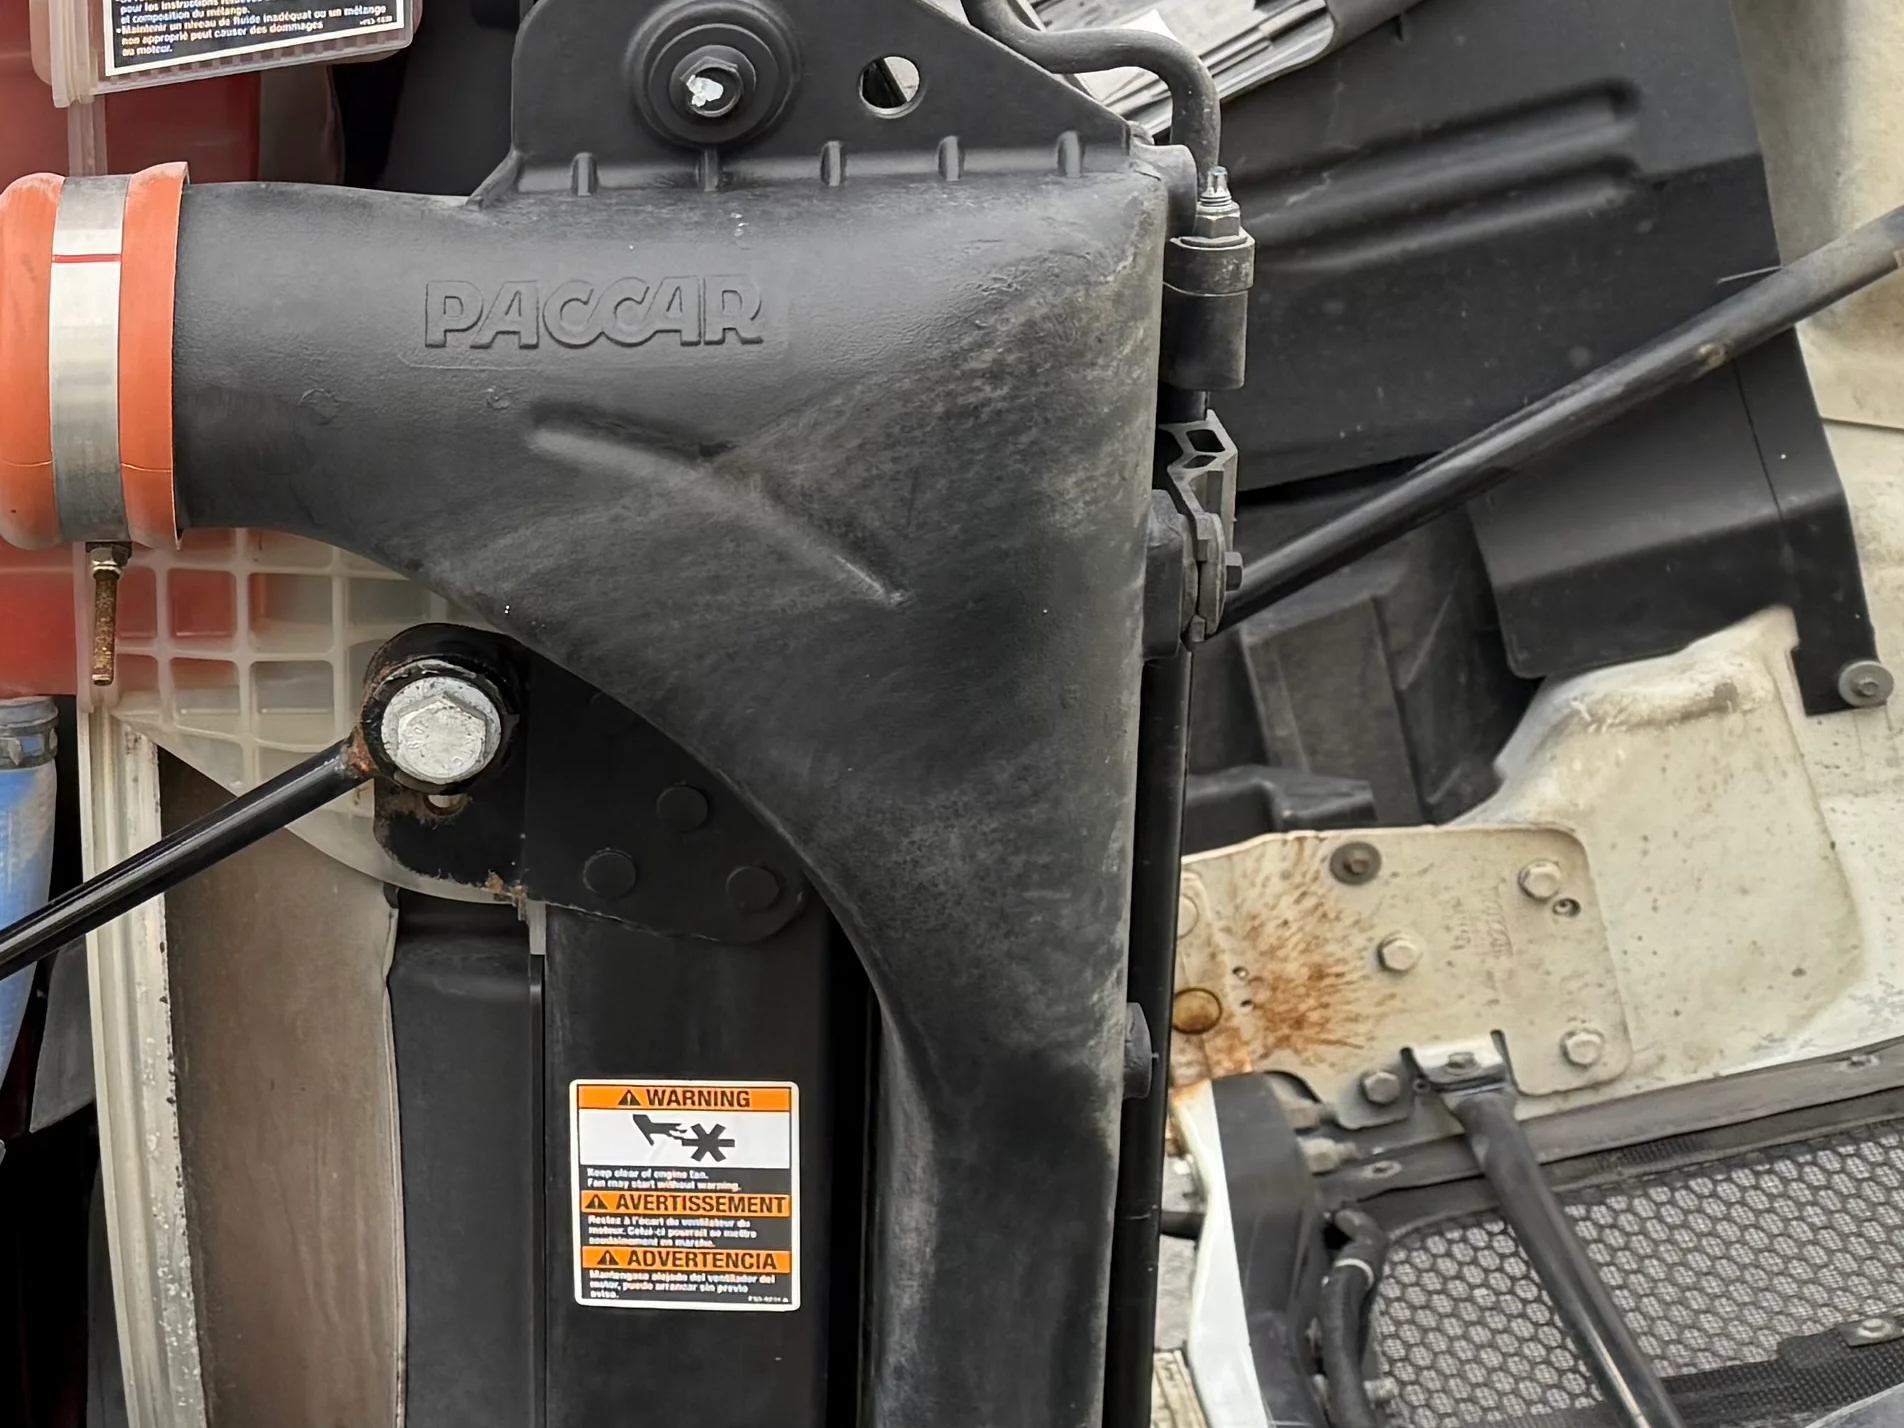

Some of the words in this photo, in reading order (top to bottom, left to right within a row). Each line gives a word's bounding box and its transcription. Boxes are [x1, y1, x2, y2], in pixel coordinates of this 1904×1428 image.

[424, 273, 765, 350] PACCAR
[645, 1089, 751, 1107] WARNING
[616, 1195, 787, 1213] AVERTISSEMENT
[627, 1250, 777, 1270] ADVERTENCIA
